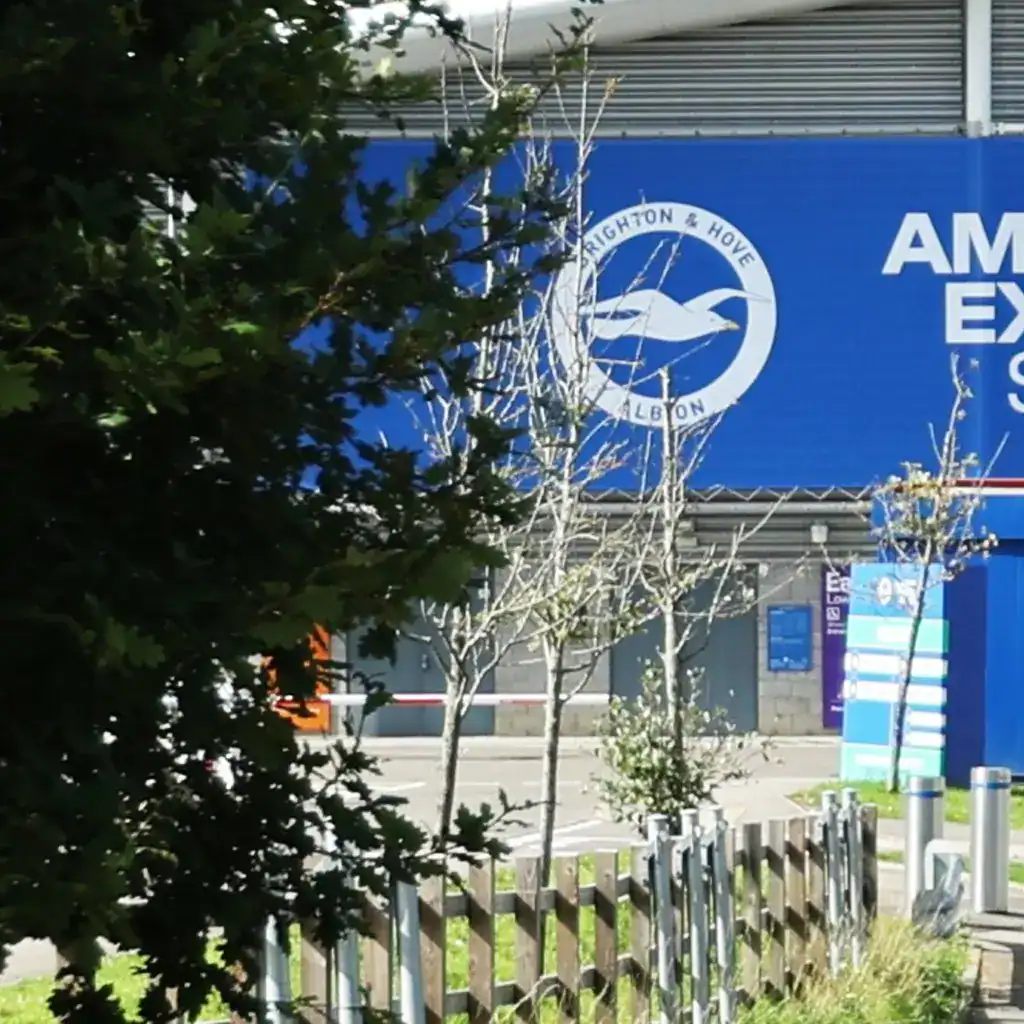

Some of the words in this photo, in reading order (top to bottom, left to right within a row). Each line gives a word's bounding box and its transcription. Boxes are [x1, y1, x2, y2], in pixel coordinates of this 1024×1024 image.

[685, 212, 698, 228] &
[707, 221, 756, 268] HOVE
[619, 397, 705, 422] ALBON
